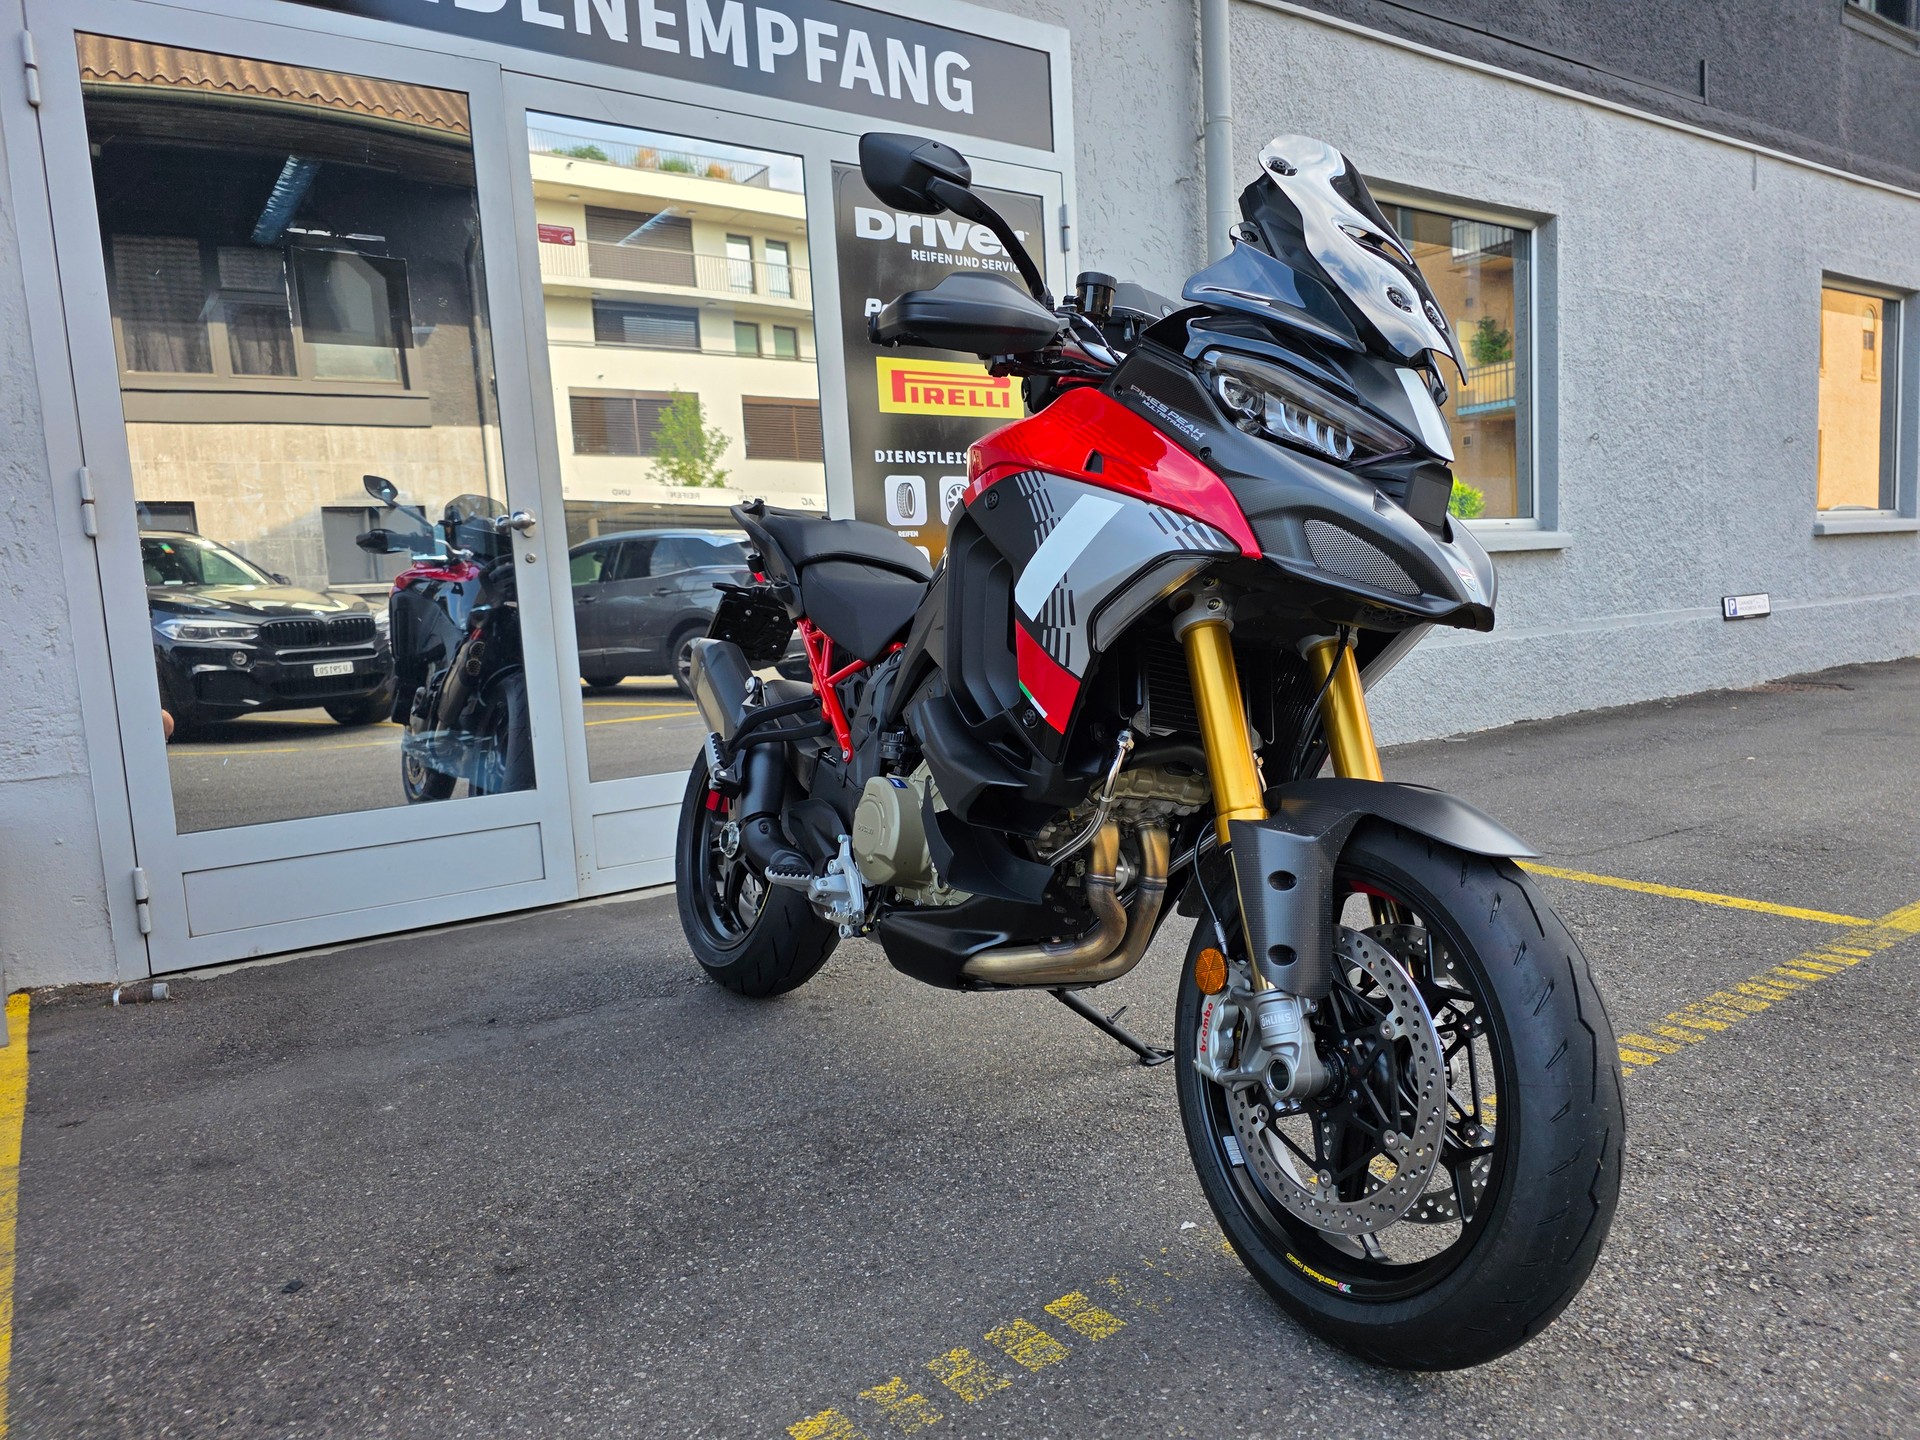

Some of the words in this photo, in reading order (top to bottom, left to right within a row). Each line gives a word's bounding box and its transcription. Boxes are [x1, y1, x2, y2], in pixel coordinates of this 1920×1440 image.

[911, 249, 952, 264] REIFEN
[955, 254, 980, 268] UND
[890, 370, 1011, 408] PIRELLI
[1130, 384, 1170, 413] PIKES
[1168, 410, 1206, 438] PEAK
[1142, 399, 1190, 435] MULTISTRADA
[1199, 1002, 1214, 1053] brembo
[1261, 1012, 1292, 1028] ÖHLINS
[1303, 1264, 1339, 1288] marchesini
